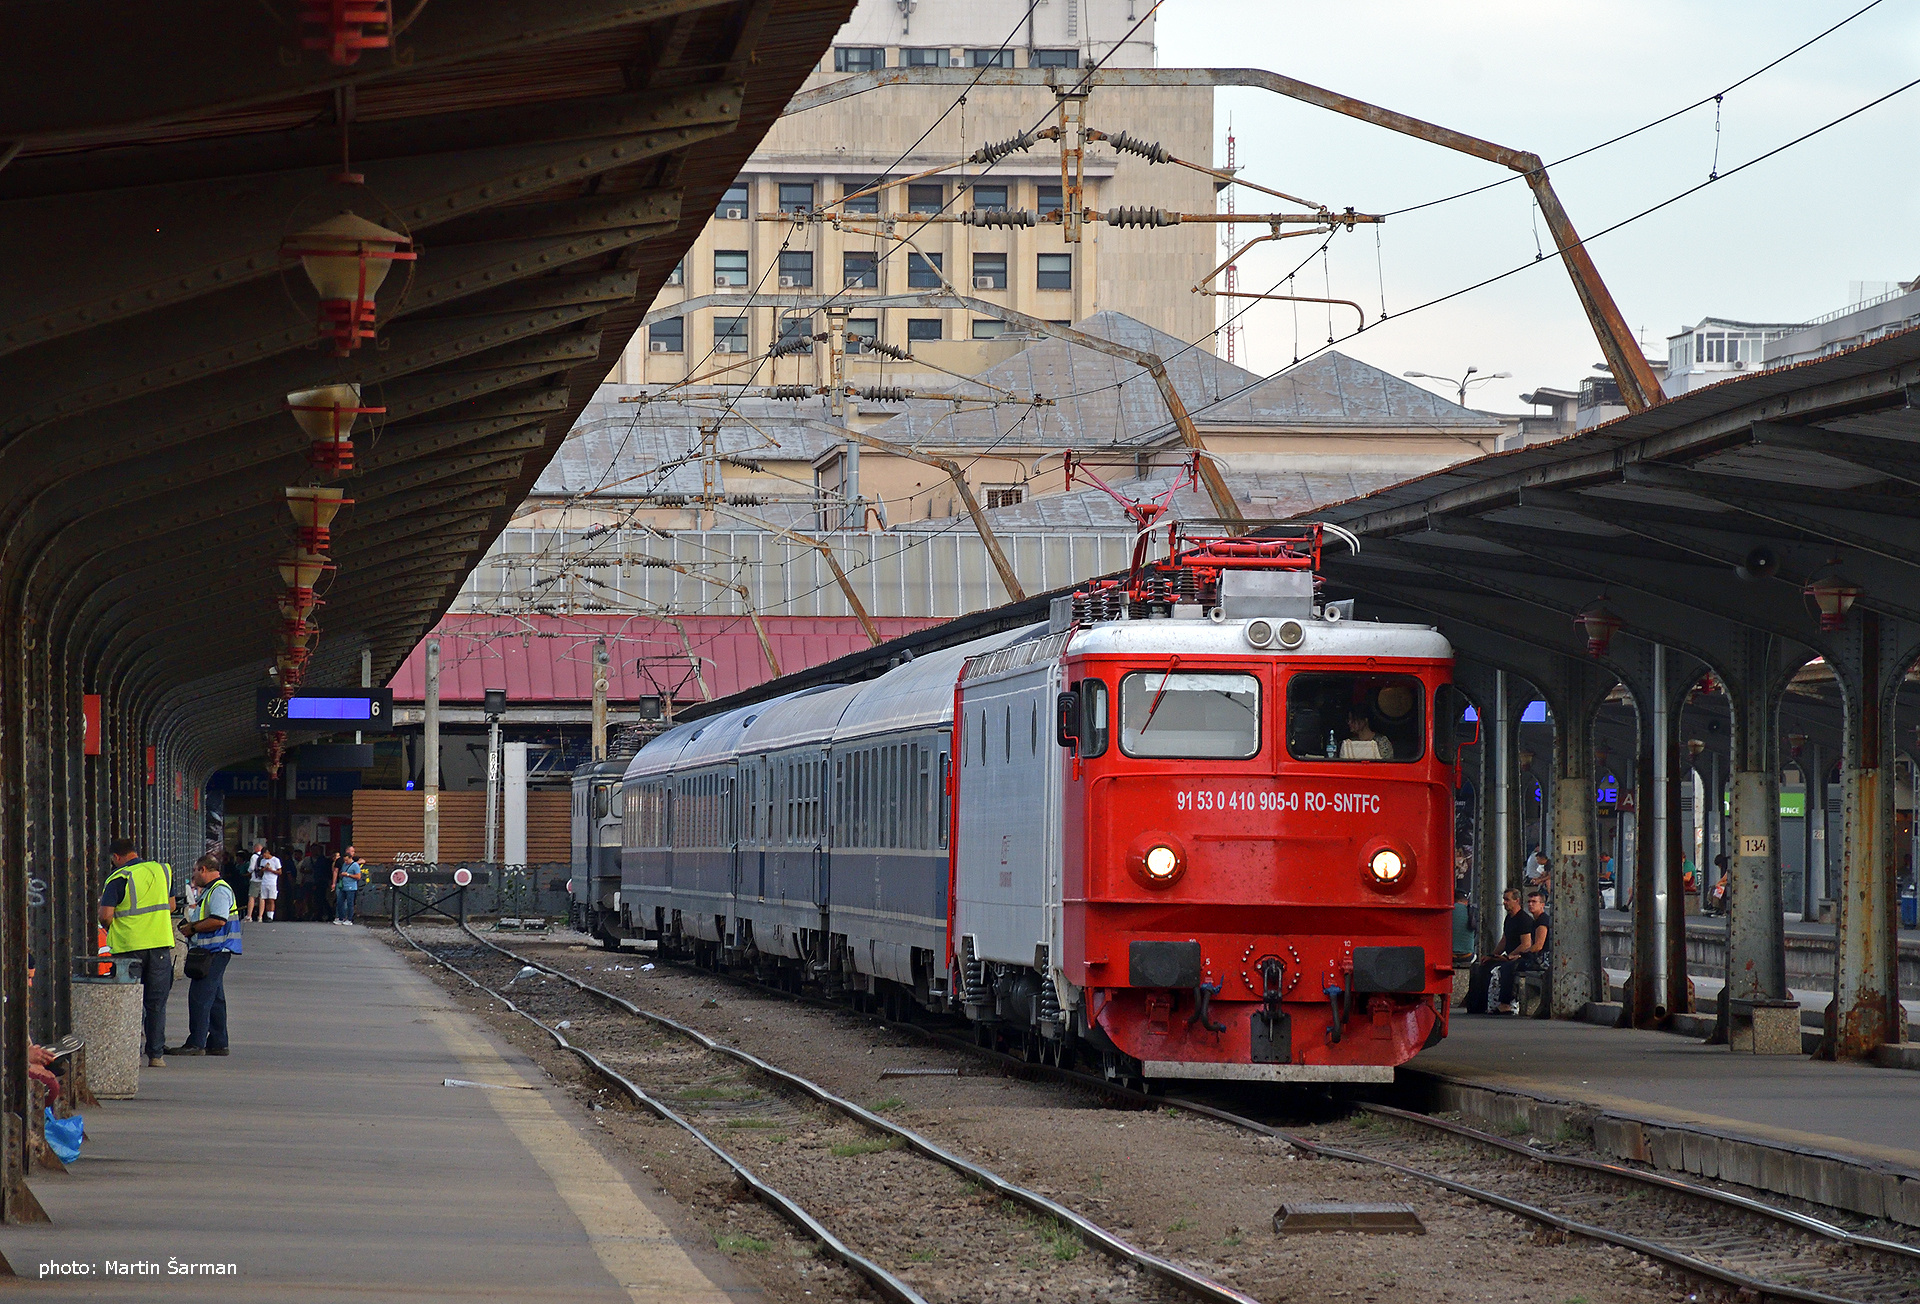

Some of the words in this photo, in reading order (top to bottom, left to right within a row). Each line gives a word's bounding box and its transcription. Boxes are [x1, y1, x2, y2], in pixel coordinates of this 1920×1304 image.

[371, 701, 380, 716] 6
[233, 775, 328, 791] Infoatii
[1177, 791, 1192, 810] 91
[1197, 791, 1213, 810] 53
[1217, 791, 1225, 810] 0
[1229, 791, 1255, 810] 410
[1259, 792, 1299, 811] 905-0
[1304, 792, 1380, 813] RO-SNTFC
[1622, 793, 1634, 806] A
[1567, 840, 1584, 854] 119
[1745, 839, 1766, 852] 134
